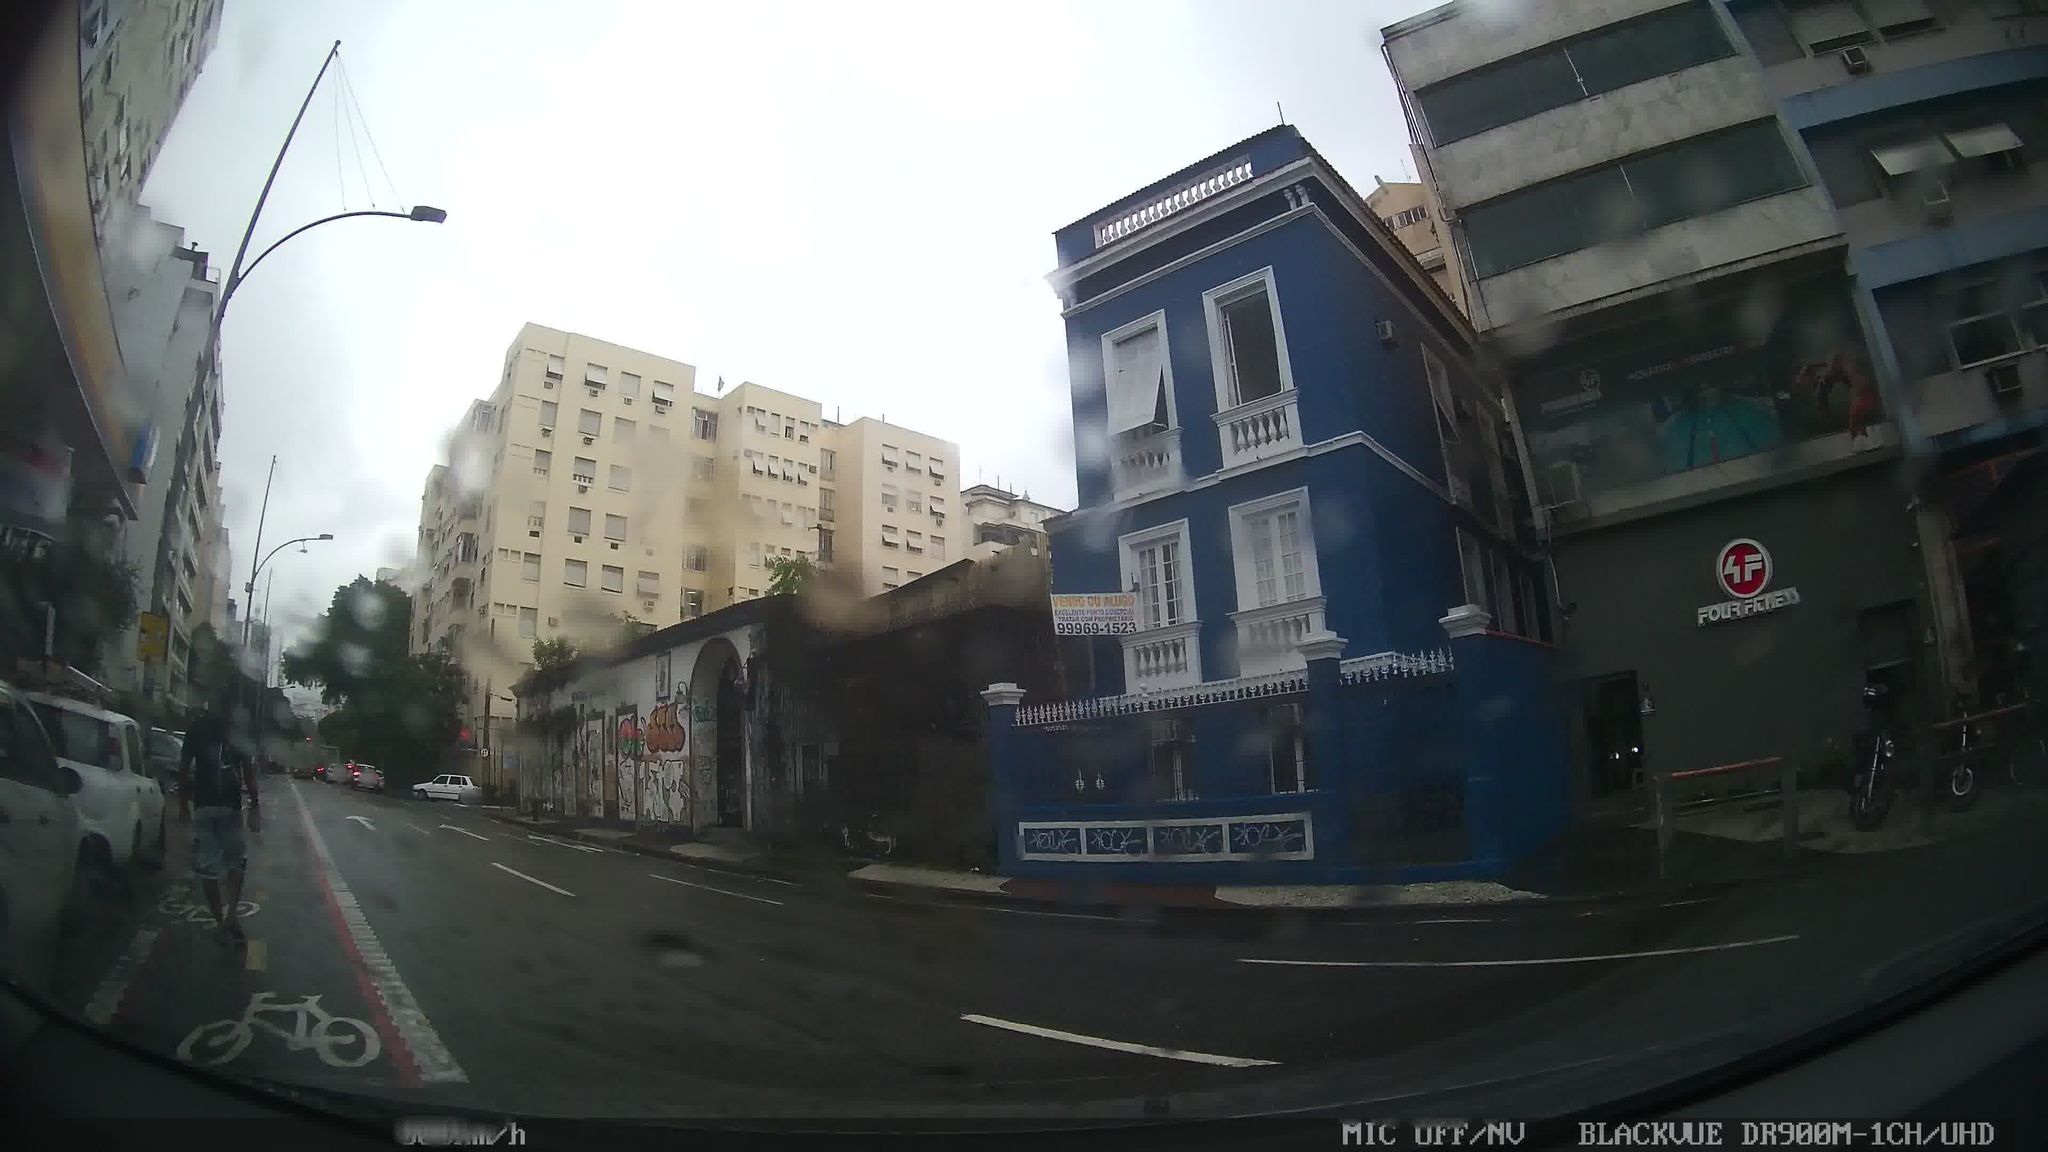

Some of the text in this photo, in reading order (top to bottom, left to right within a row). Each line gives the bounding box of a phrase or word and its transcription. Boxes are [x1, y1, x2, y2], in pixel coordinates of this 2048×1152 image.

[1723, 553, 1763, 584] 4F
[1054, 595, 1135, 607] VENDO OU ALUGO
[1698, 602, 1741, 627] FOUR
[1057, 622, 1137, 635] 99969-1523
